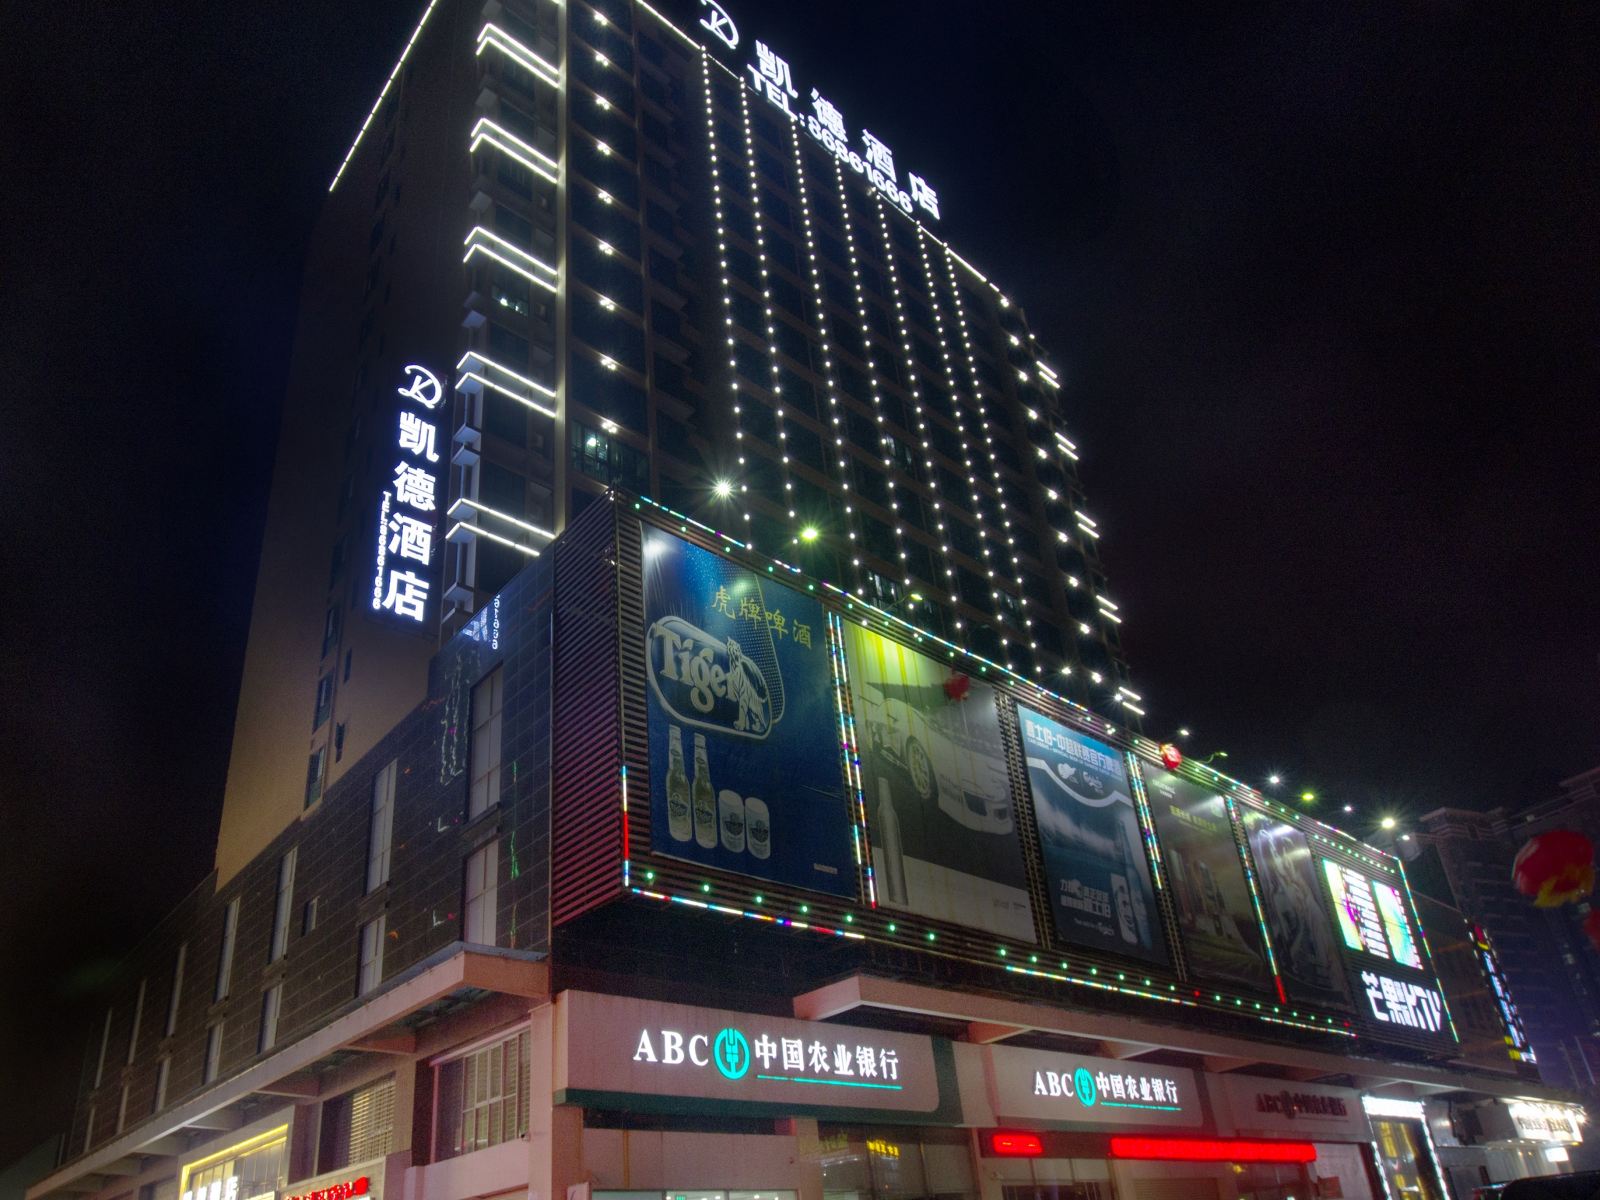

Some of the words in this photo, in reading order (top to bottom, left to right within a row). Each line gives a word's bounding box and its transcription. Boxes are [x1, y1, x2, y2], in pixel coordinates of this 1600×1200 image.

[755, 39, 941, 221] 凯德酒店
[382, 410, 441, 623] 凯德酒店
[711, 584, 814, 649] 虎牌啤酒
[632, 1028, 709, 1067] ABC
[754, 1033, 899, 1081] 中国农业银行
[1033, 1070, 1074, 1098] ABC
[1095, 1070, 1179, 1105] 中国农业银行
